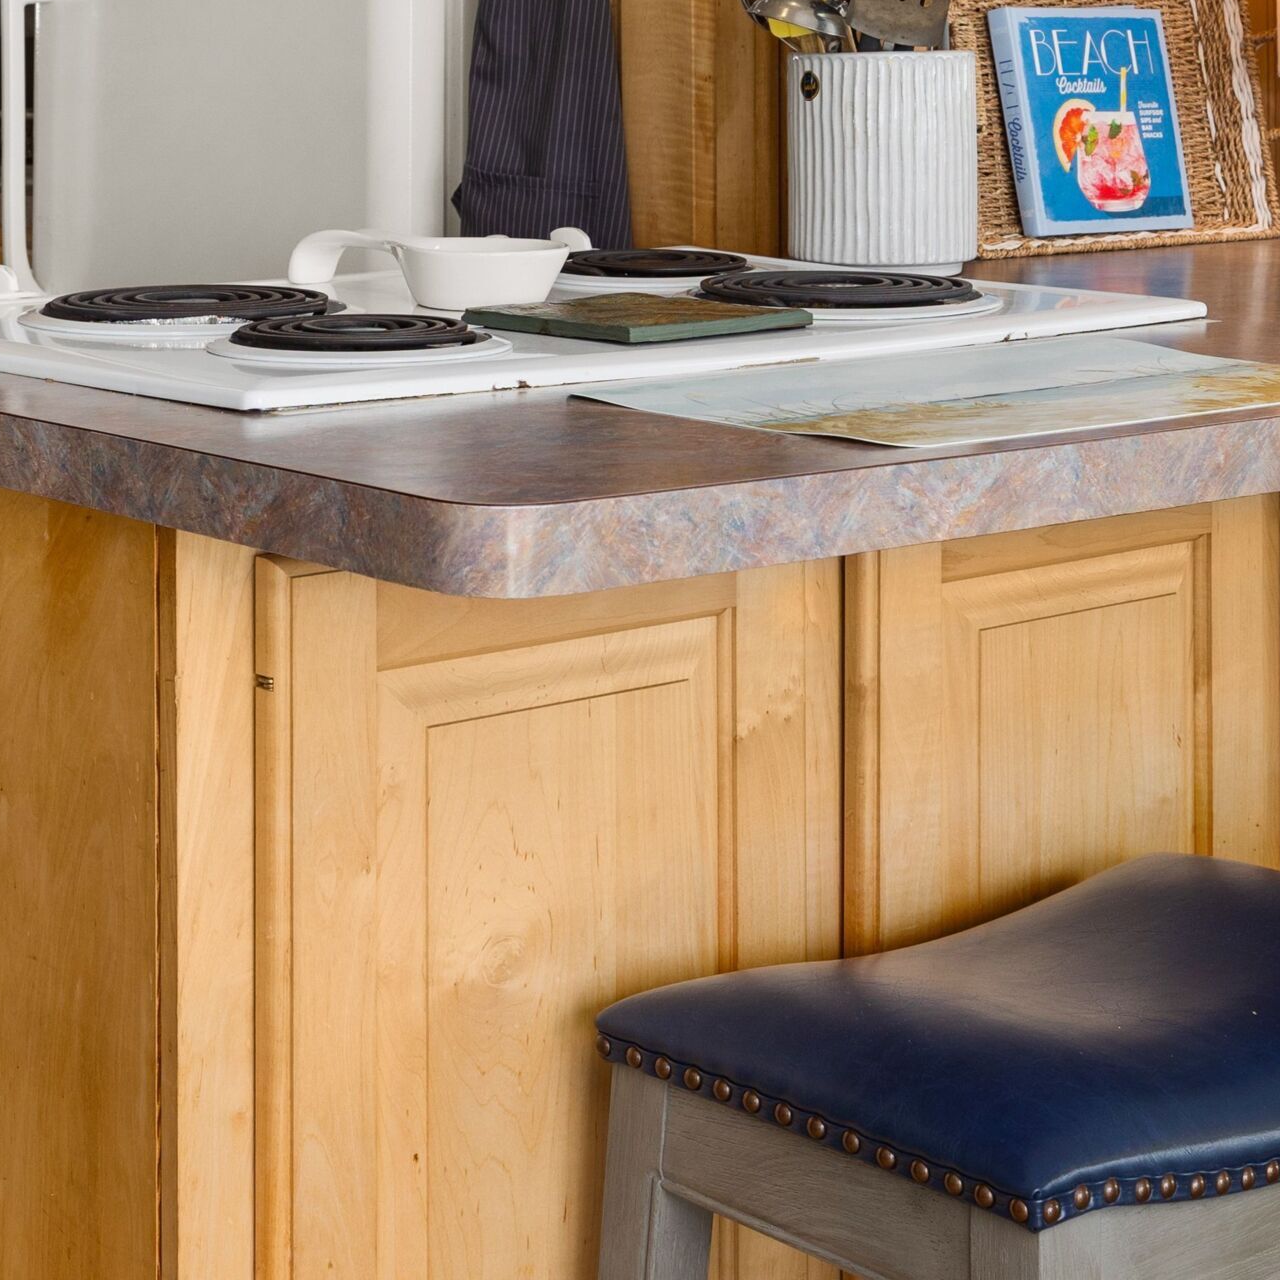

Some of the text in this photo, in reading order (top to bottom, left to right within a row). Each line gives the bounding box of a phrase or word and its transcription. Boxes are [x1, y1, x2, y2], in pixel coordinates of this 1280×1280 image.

[1029, 28, 1155, 76] BEACH
[1055, 75, 1107, 94] Cocktails
[1007, 116, 1028, 184] Cocktails
